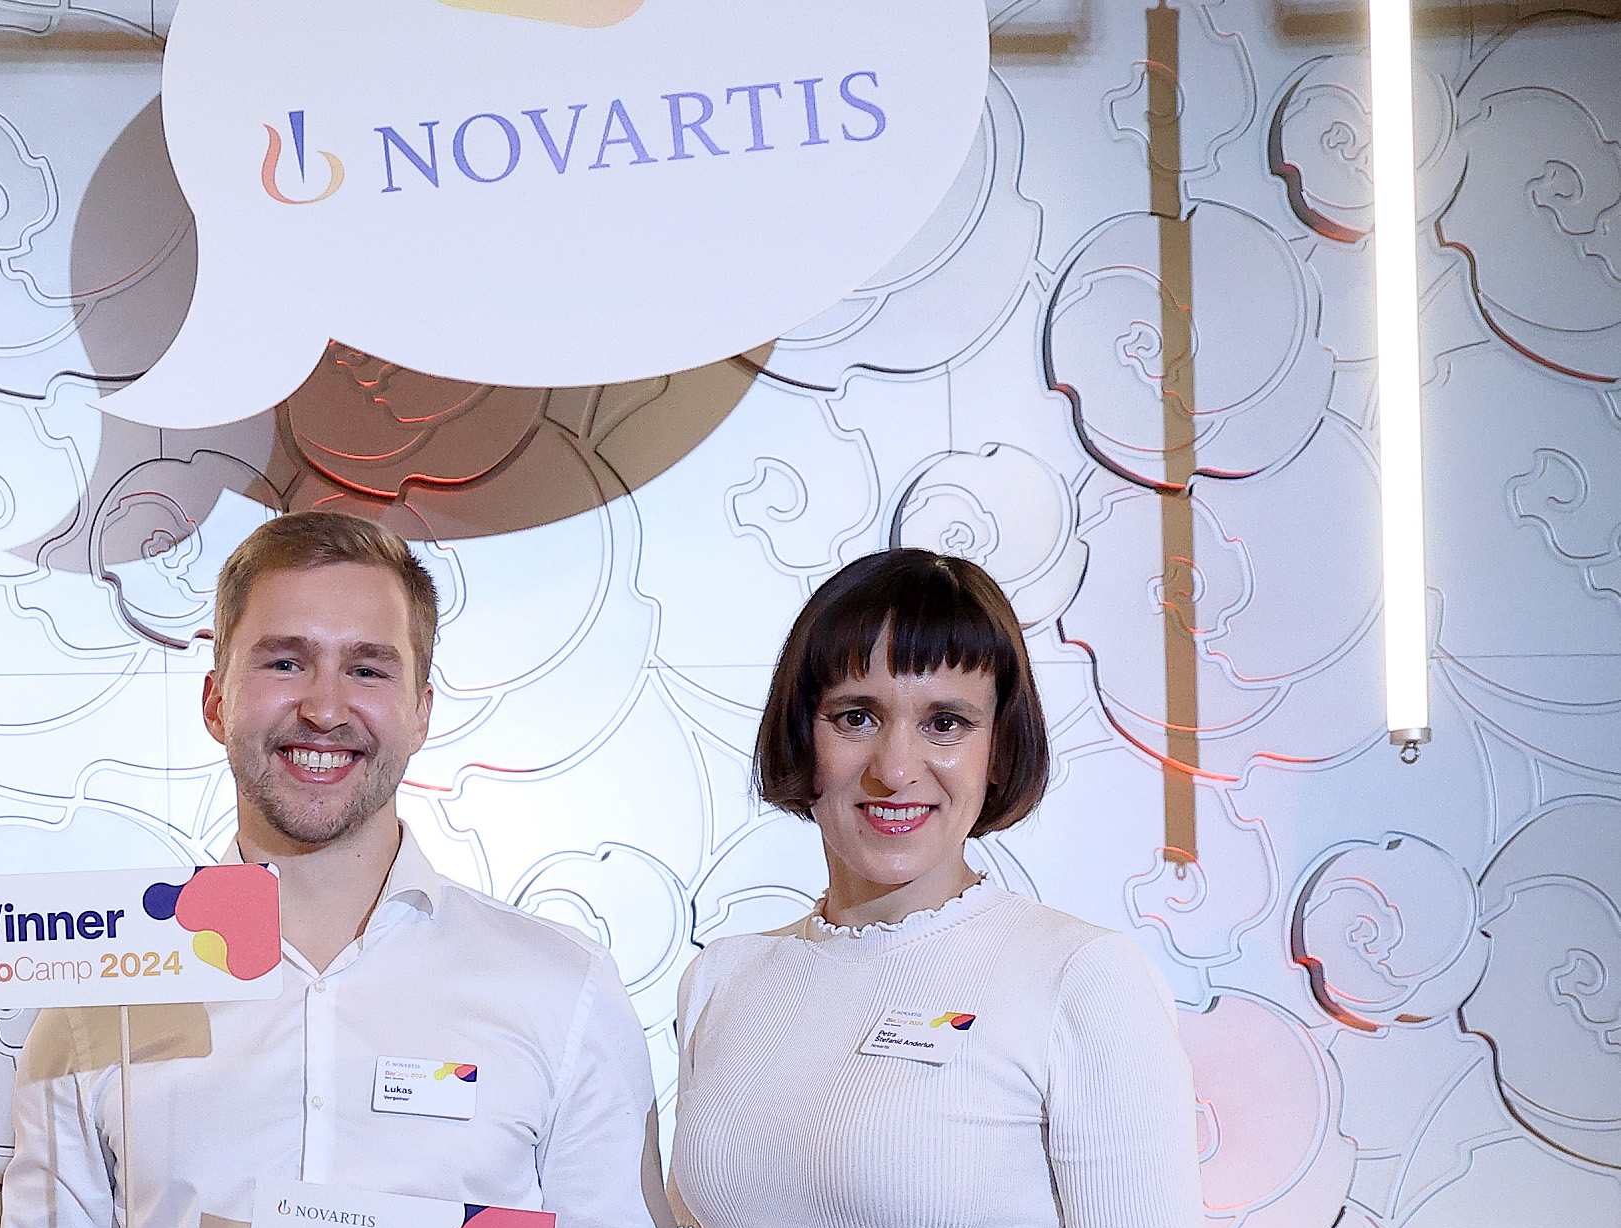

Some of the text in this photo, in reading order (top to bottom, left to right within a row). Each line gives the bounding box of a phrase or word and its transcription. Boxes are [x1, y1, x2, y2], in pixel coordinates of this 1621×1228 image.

[374, 70, 888, 193] NOVARTIS
[100, 951, 183, 978] 2024
[384, 1085, 413, 1094] Lukas
[295, 1205, 376, 1227] NOVARTIS
